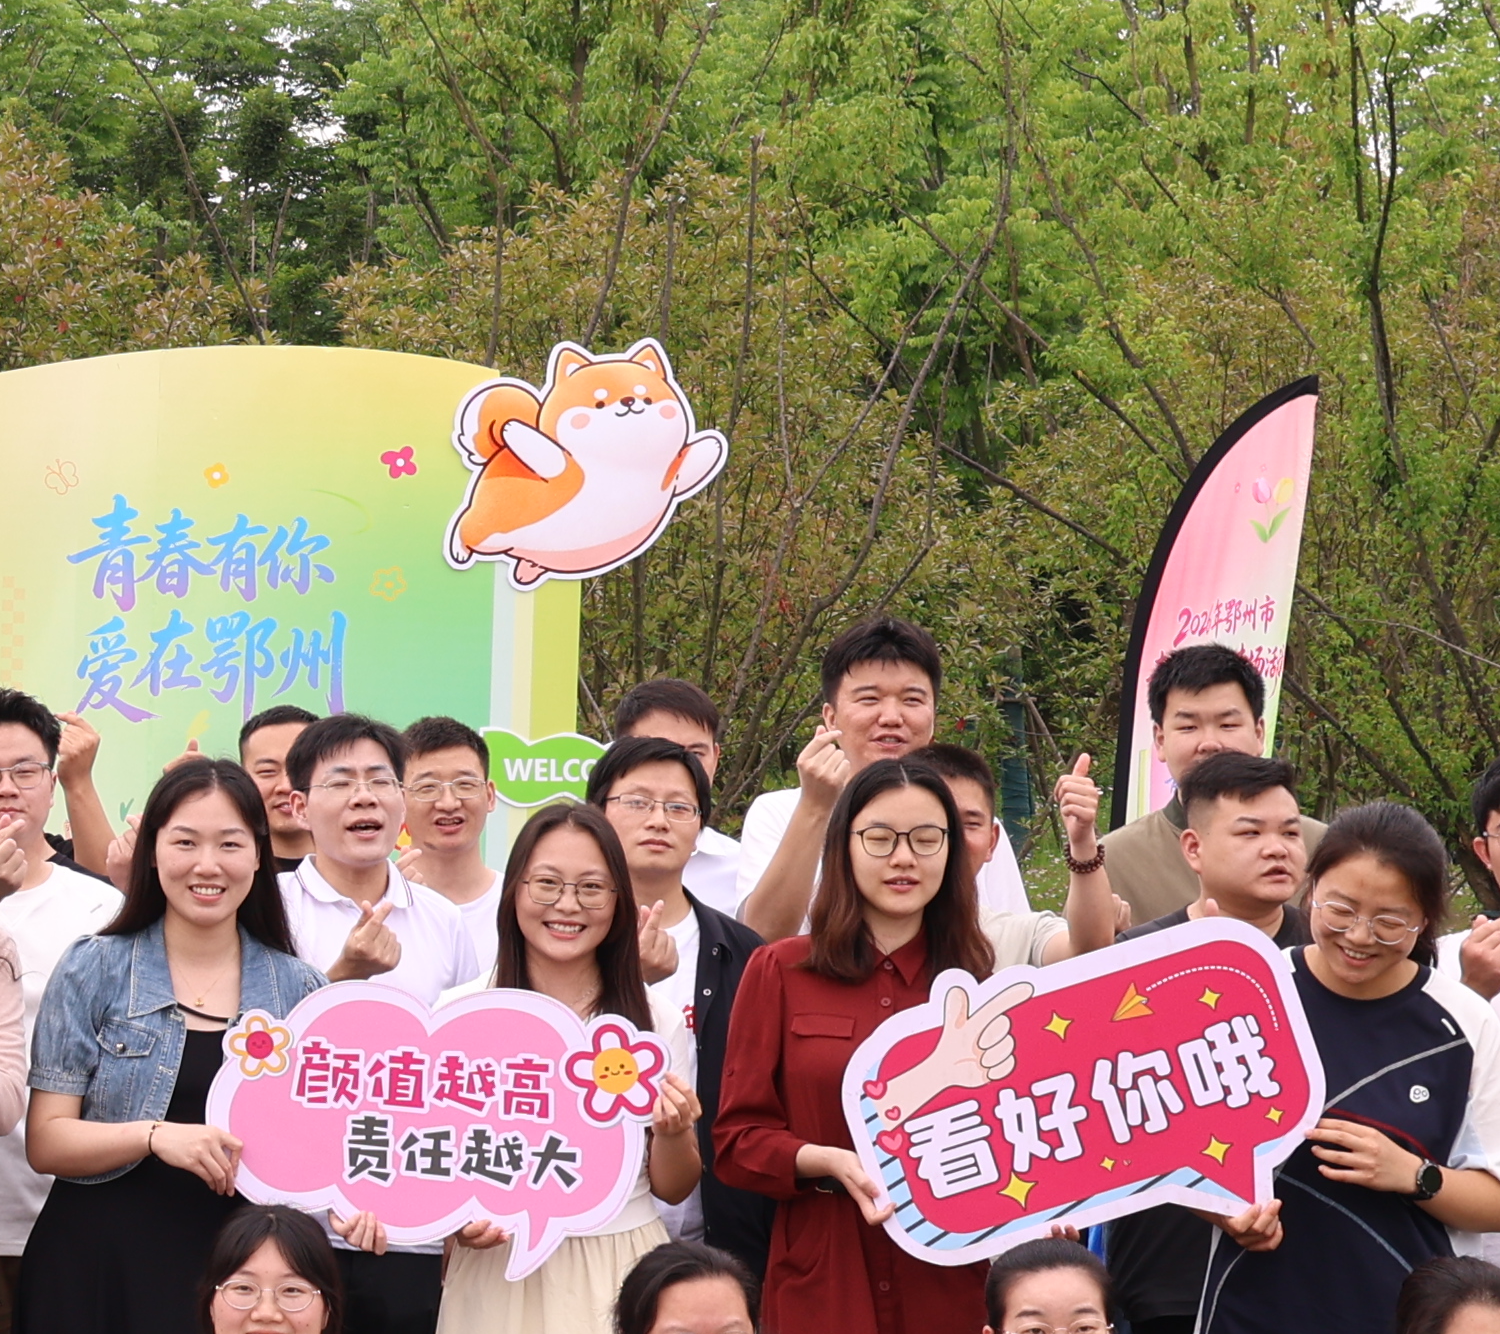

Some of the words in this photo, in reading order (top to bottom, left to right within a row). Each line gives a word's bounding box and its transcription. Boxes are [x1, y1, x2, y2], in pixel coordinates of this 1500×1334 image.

[66, 493, 335, 612] 青春有你
[75, 609, 347, 723] 爱在鄂州
[295, 1041, 552, 1121] 颜值越高
[905, 1015, 1279, 1199] 看好你哦
[345, 1115, 579, 1188] 责任越大
